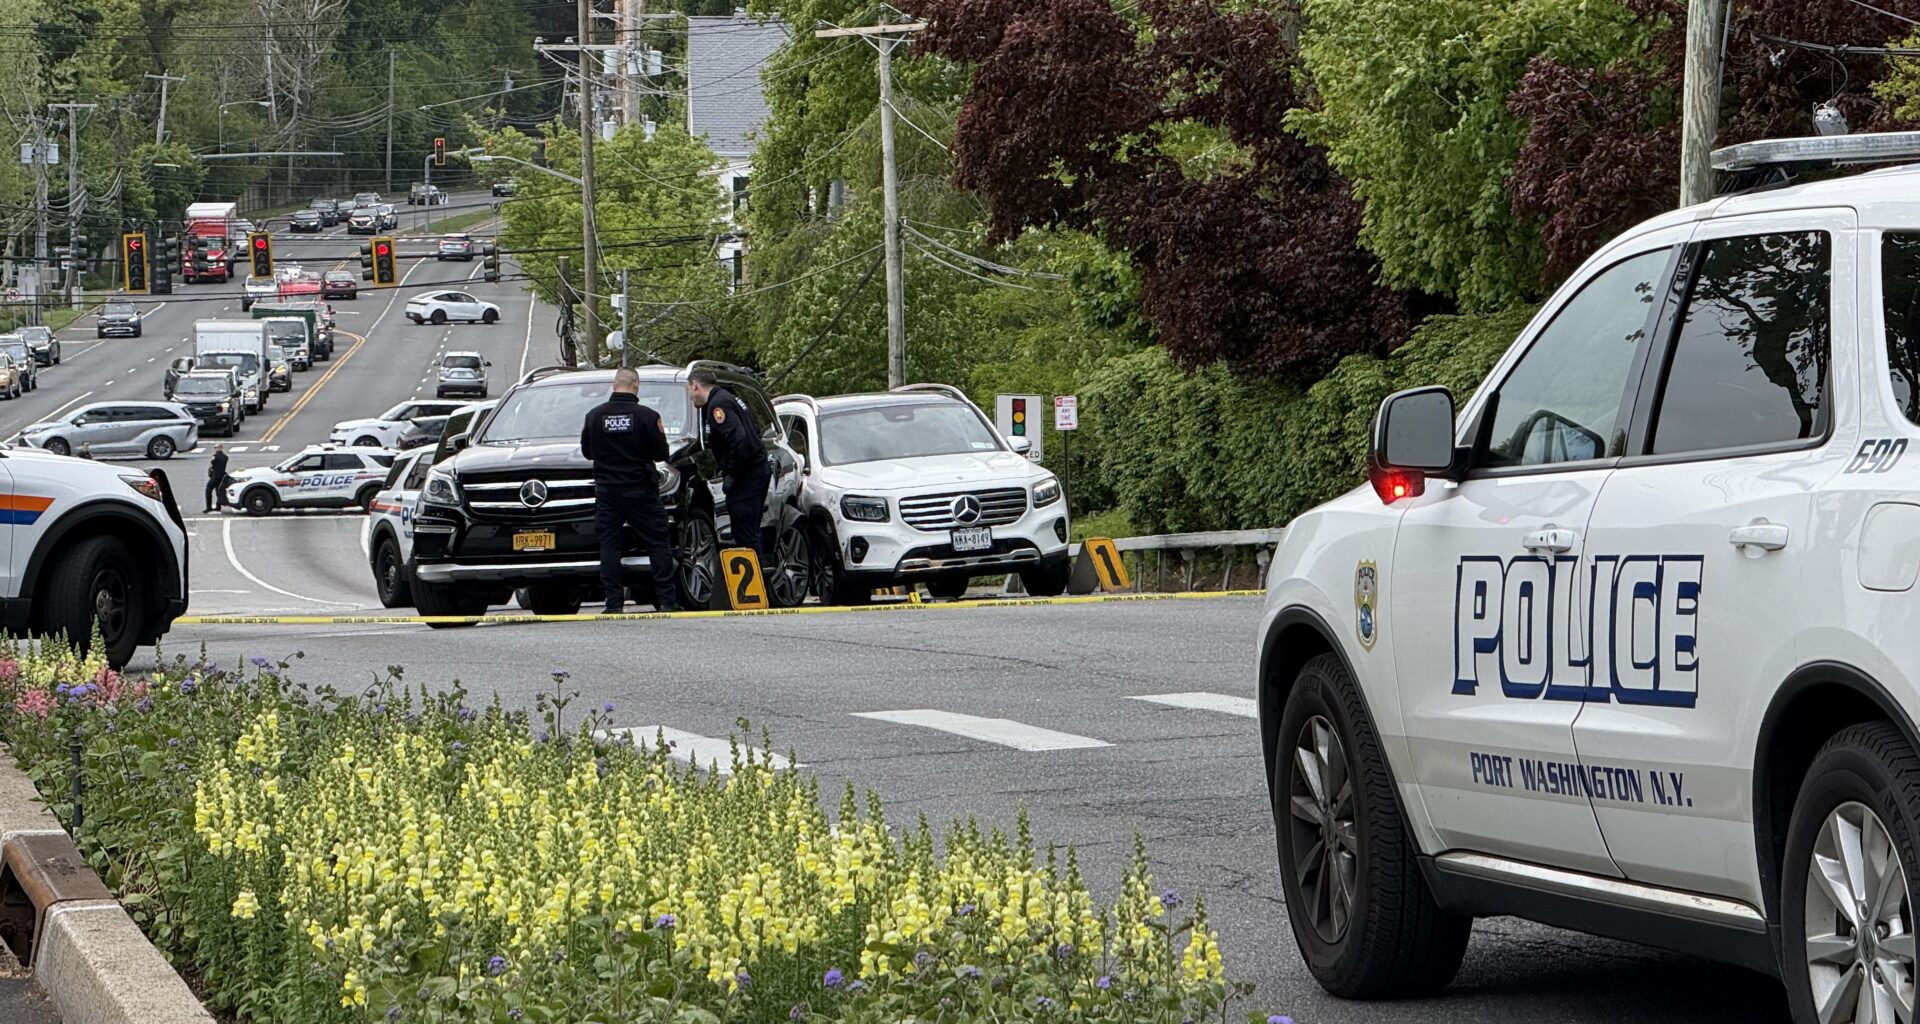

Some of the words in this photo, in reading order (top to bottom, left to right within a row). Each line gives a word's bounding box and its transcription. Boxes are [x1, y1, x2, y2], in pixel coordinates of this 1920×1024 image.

[605, 418, 631, 428] POLICE
[1843, 438, 1909, 474] 690
[301, 475, 354, 487] POLICE
[730, 556, 761, 604] 2
[1095, 545, 1121, 586] 1
[1451, 554, 1704, 709] POLICE
[1470, 752, 1513, 788] PORT
[1519, 758, 1644, 803] WASHINGTON
[1650, 771, 1693, 808] N.Y.
